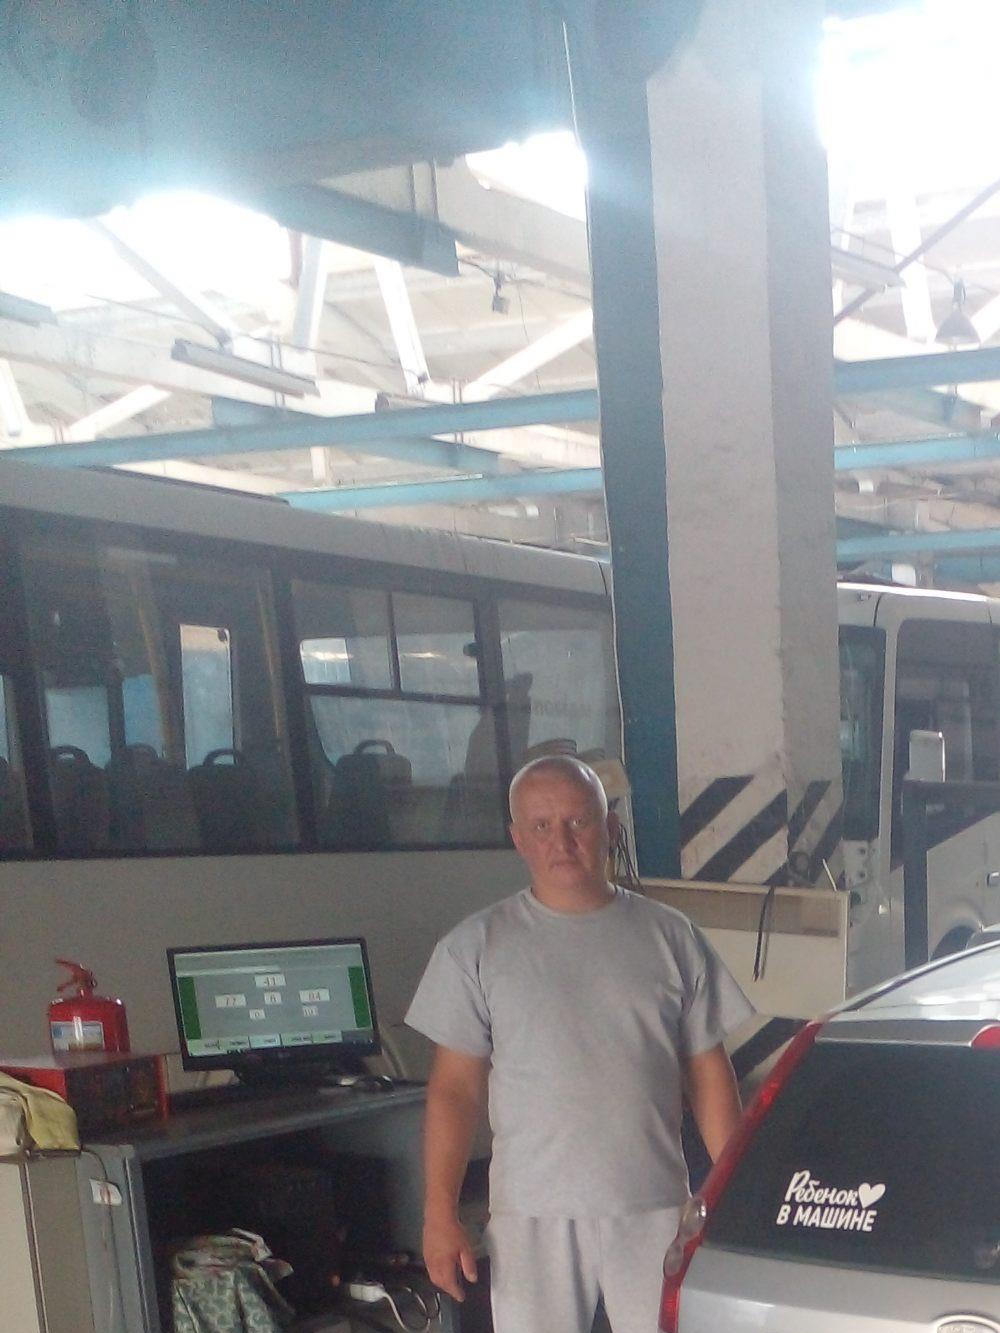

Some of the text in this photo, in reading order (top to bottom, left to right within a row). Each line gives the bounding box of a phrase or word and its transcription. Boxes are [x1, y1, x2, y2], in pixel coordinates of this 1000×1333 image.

[783, 1170, 858, 1207] Ребенок
[776, 1204, 877, 1232] В МАШИНЕ
